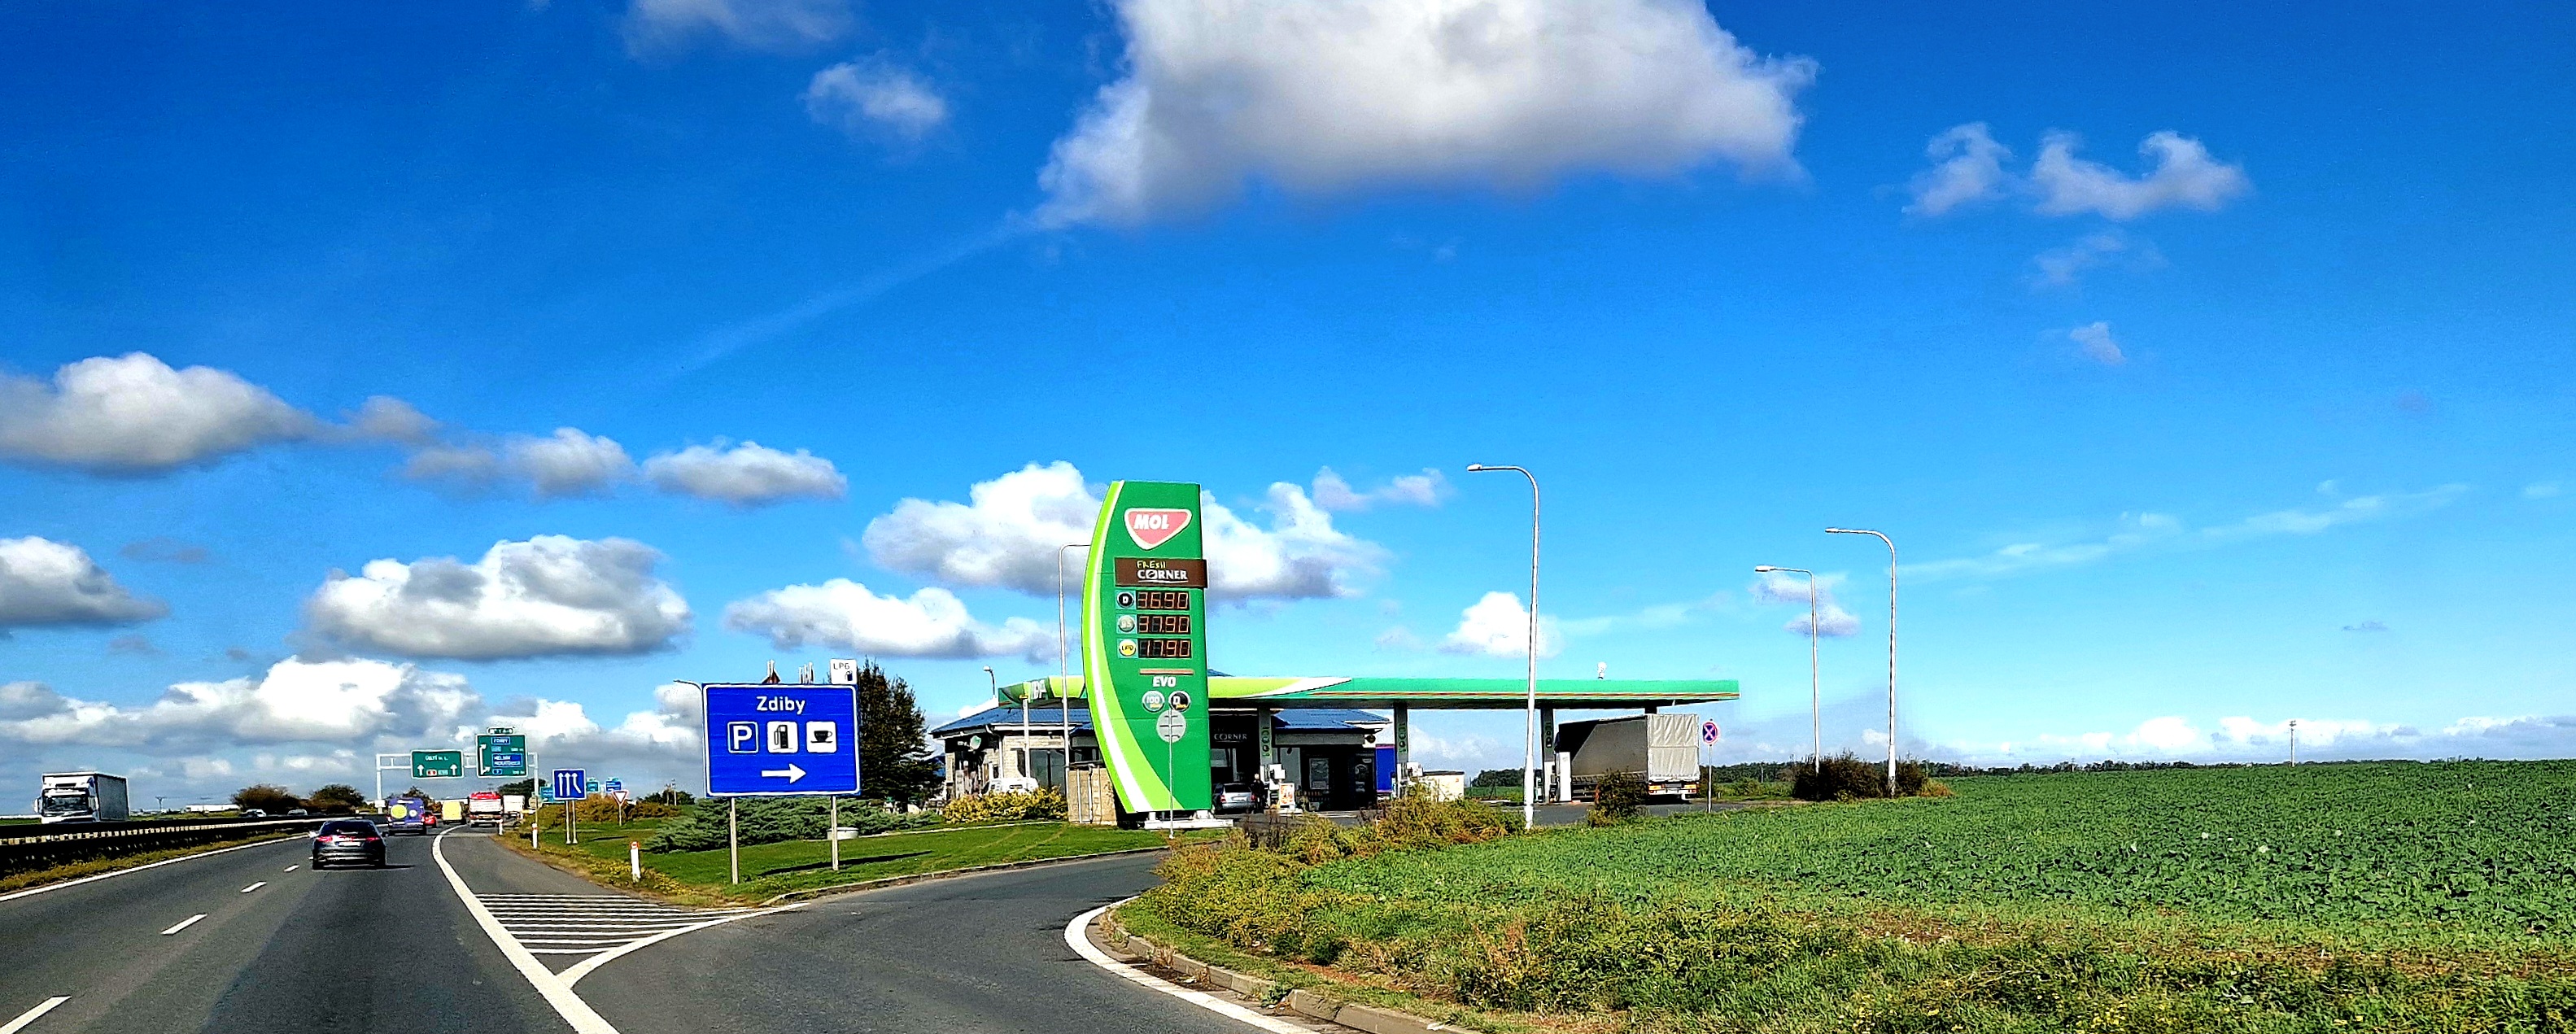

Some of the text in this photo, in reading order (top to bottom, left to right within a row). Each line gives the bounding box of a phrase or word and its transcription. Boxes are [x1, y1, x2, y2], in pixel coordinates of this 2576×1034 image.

[1134, 513, 1169, 530] MOL
[1137, 569, 1188, 580] CORNER
[1122, 596, 1129, 604] D
[1137, 591, 1189, 609] 36.90
[1139, 615, 1190, 633] 37.90
[1146, 639, 1190, 657] 17.90
[833, 661, 850, 670] LPG
[1152, 676, 1177, 687] EVO
[756, 696, 806, 714] Zdiby
[1146, 696, 1160, 704] 100
[1172, 696, 1181, 705] D
[732, 725, 753, 750] P
